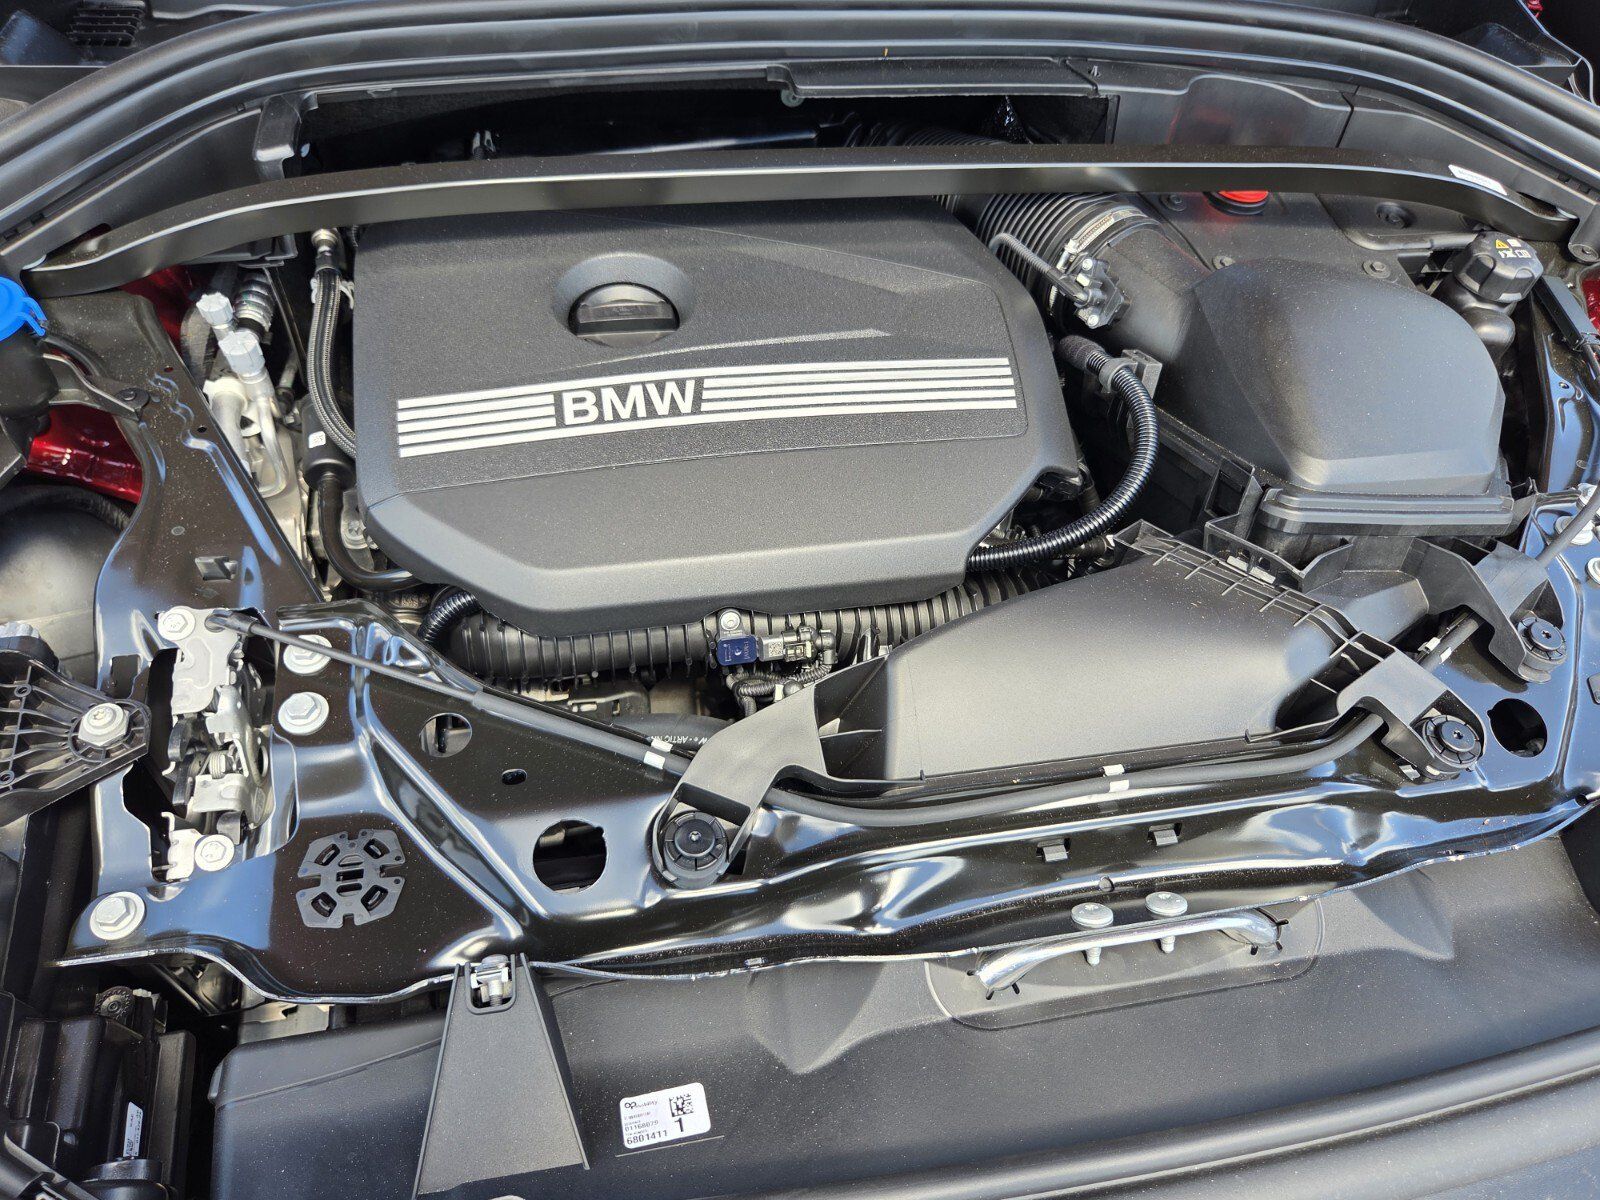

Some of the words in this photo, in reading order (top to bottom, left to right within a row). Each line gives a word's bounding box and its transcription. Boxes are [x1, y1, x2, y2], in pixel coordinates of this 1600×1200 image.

[562, 380, 695, 425] BMW
[674, 1117, 684, 1132] 1
[626, 1129, 668, 1145] 6801411
